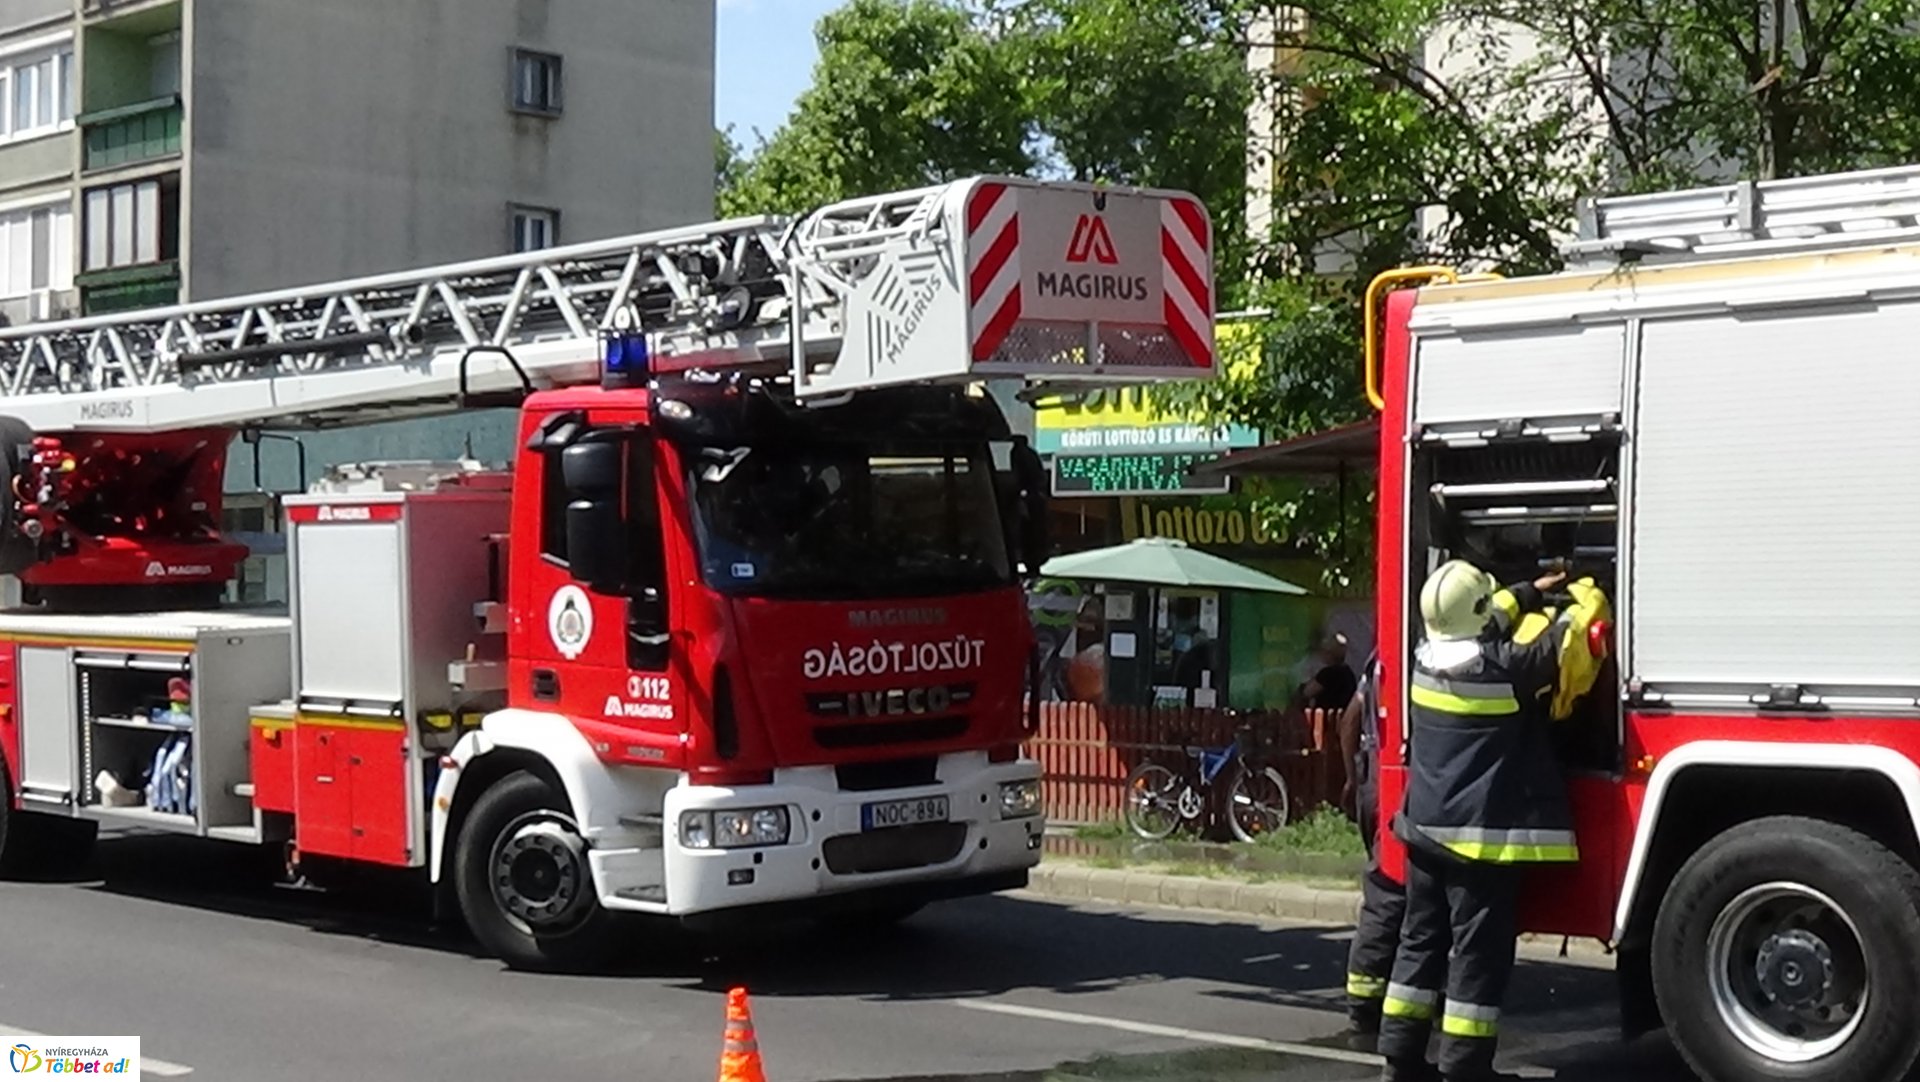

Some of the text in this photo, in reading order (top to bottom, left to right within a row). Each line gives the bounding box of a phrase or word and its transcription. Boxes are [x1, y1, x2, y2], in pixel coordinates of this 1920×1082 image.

[1037, 272, 1148, 301] MAGIRUS
[888, 273, 942, 364] MAGIRUS
[80, 400, 134, 420] MAGIRUS
[848, 607, 947, 627] MAGIRUS
[642, 677, 670, 700] 112
[623, 702, 674, 720] MAGIRUS
[847, 686, 950, 718] IVECO
[874, 801, 945, 824] NOC-894
